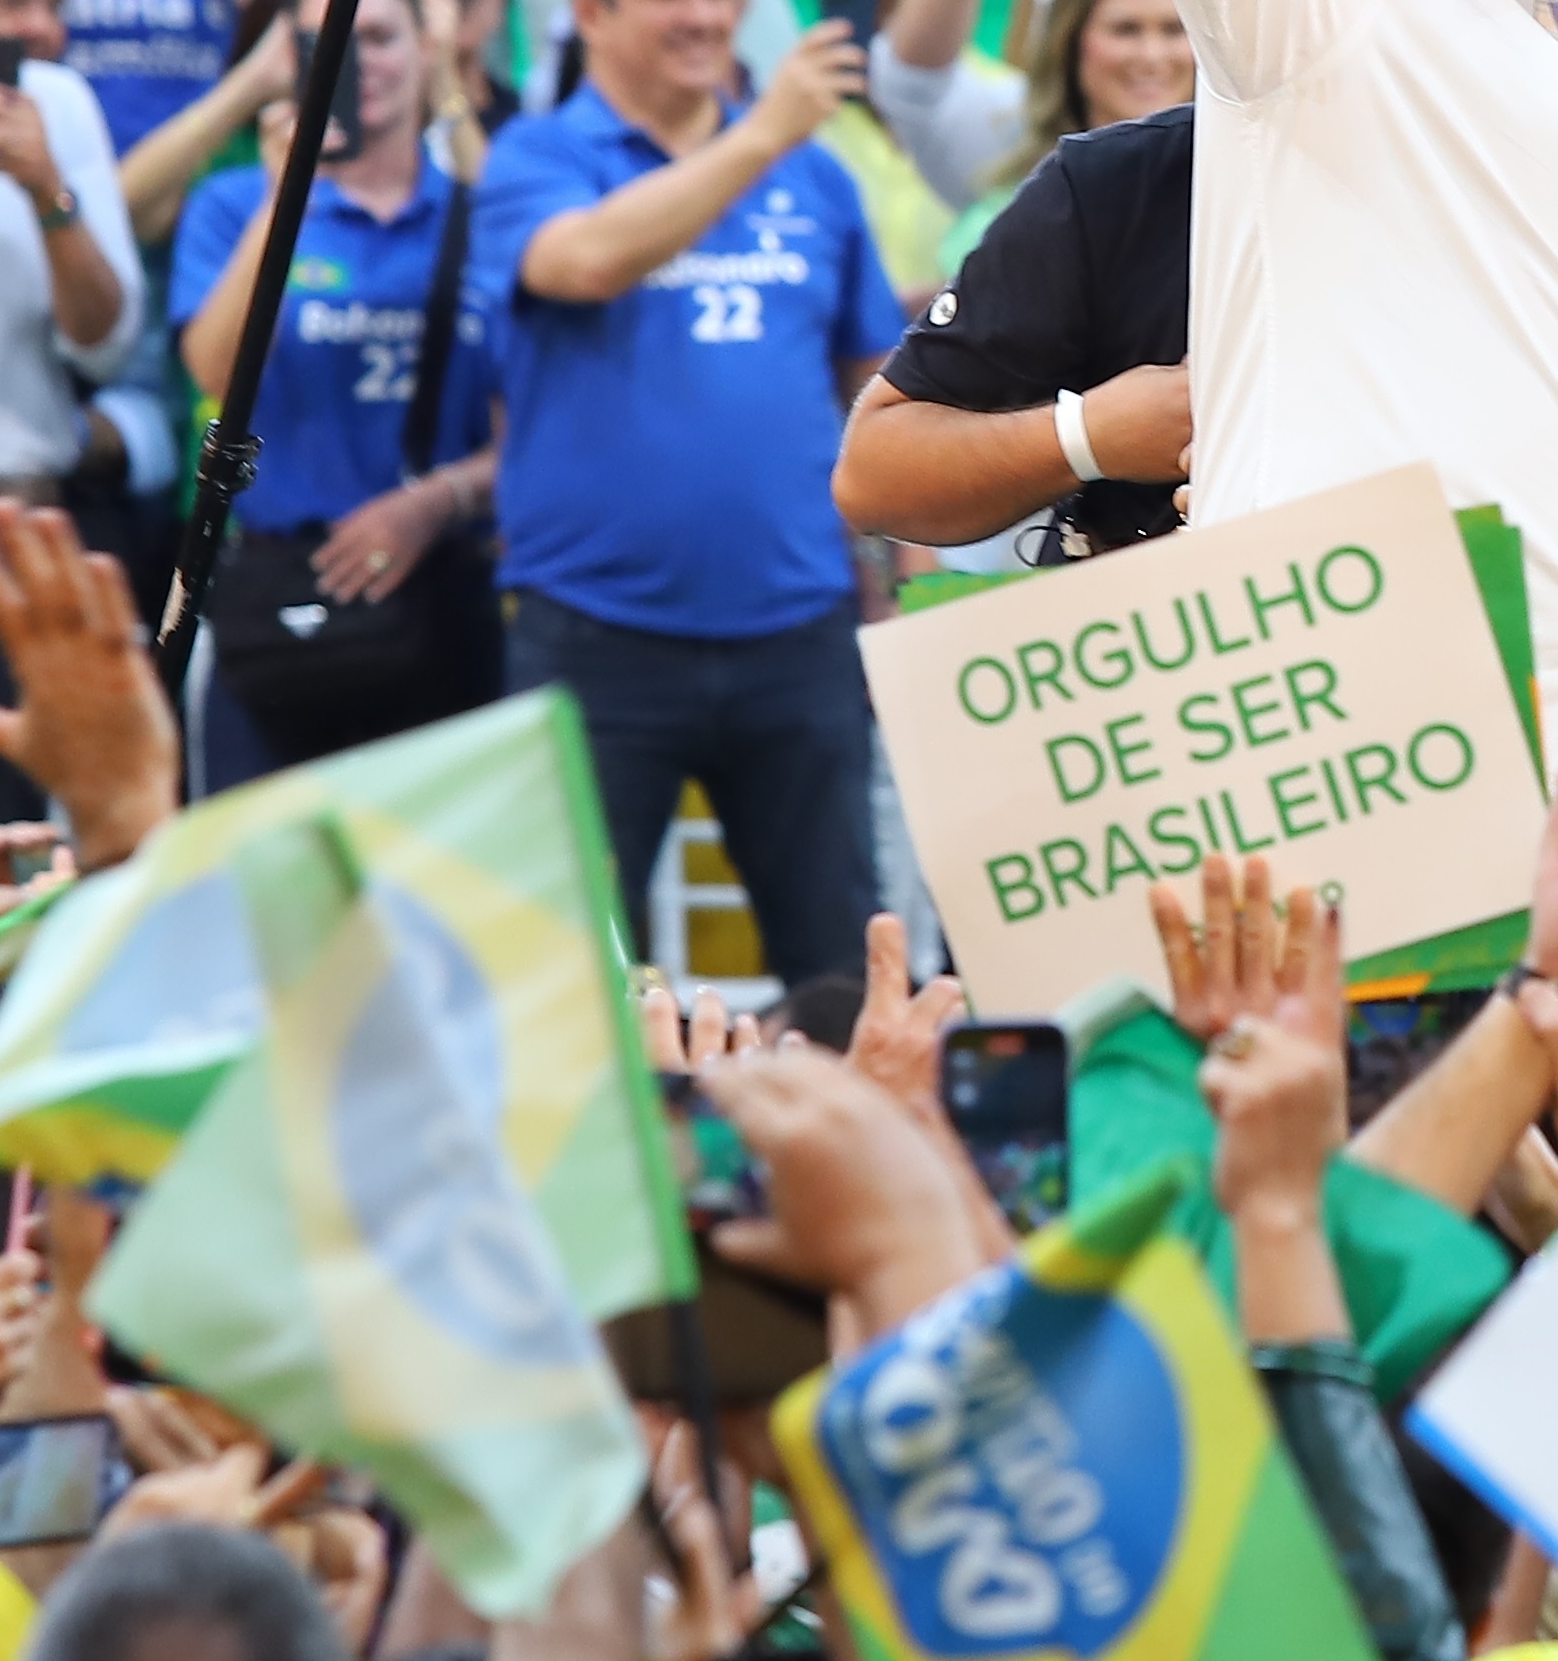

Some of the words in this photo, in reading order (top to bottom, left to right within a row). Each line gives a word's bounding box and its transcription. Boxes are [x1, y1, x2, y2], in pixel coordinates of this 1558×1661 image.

[690, 283, 765, 344] 22
[956, 544, 1386, 726] ORGULHO
[1044, 713, 1162, 805] DE
[1176, 658, 1351, 765] SER
[983, 722, 1476, 925] BRASILEIRO
